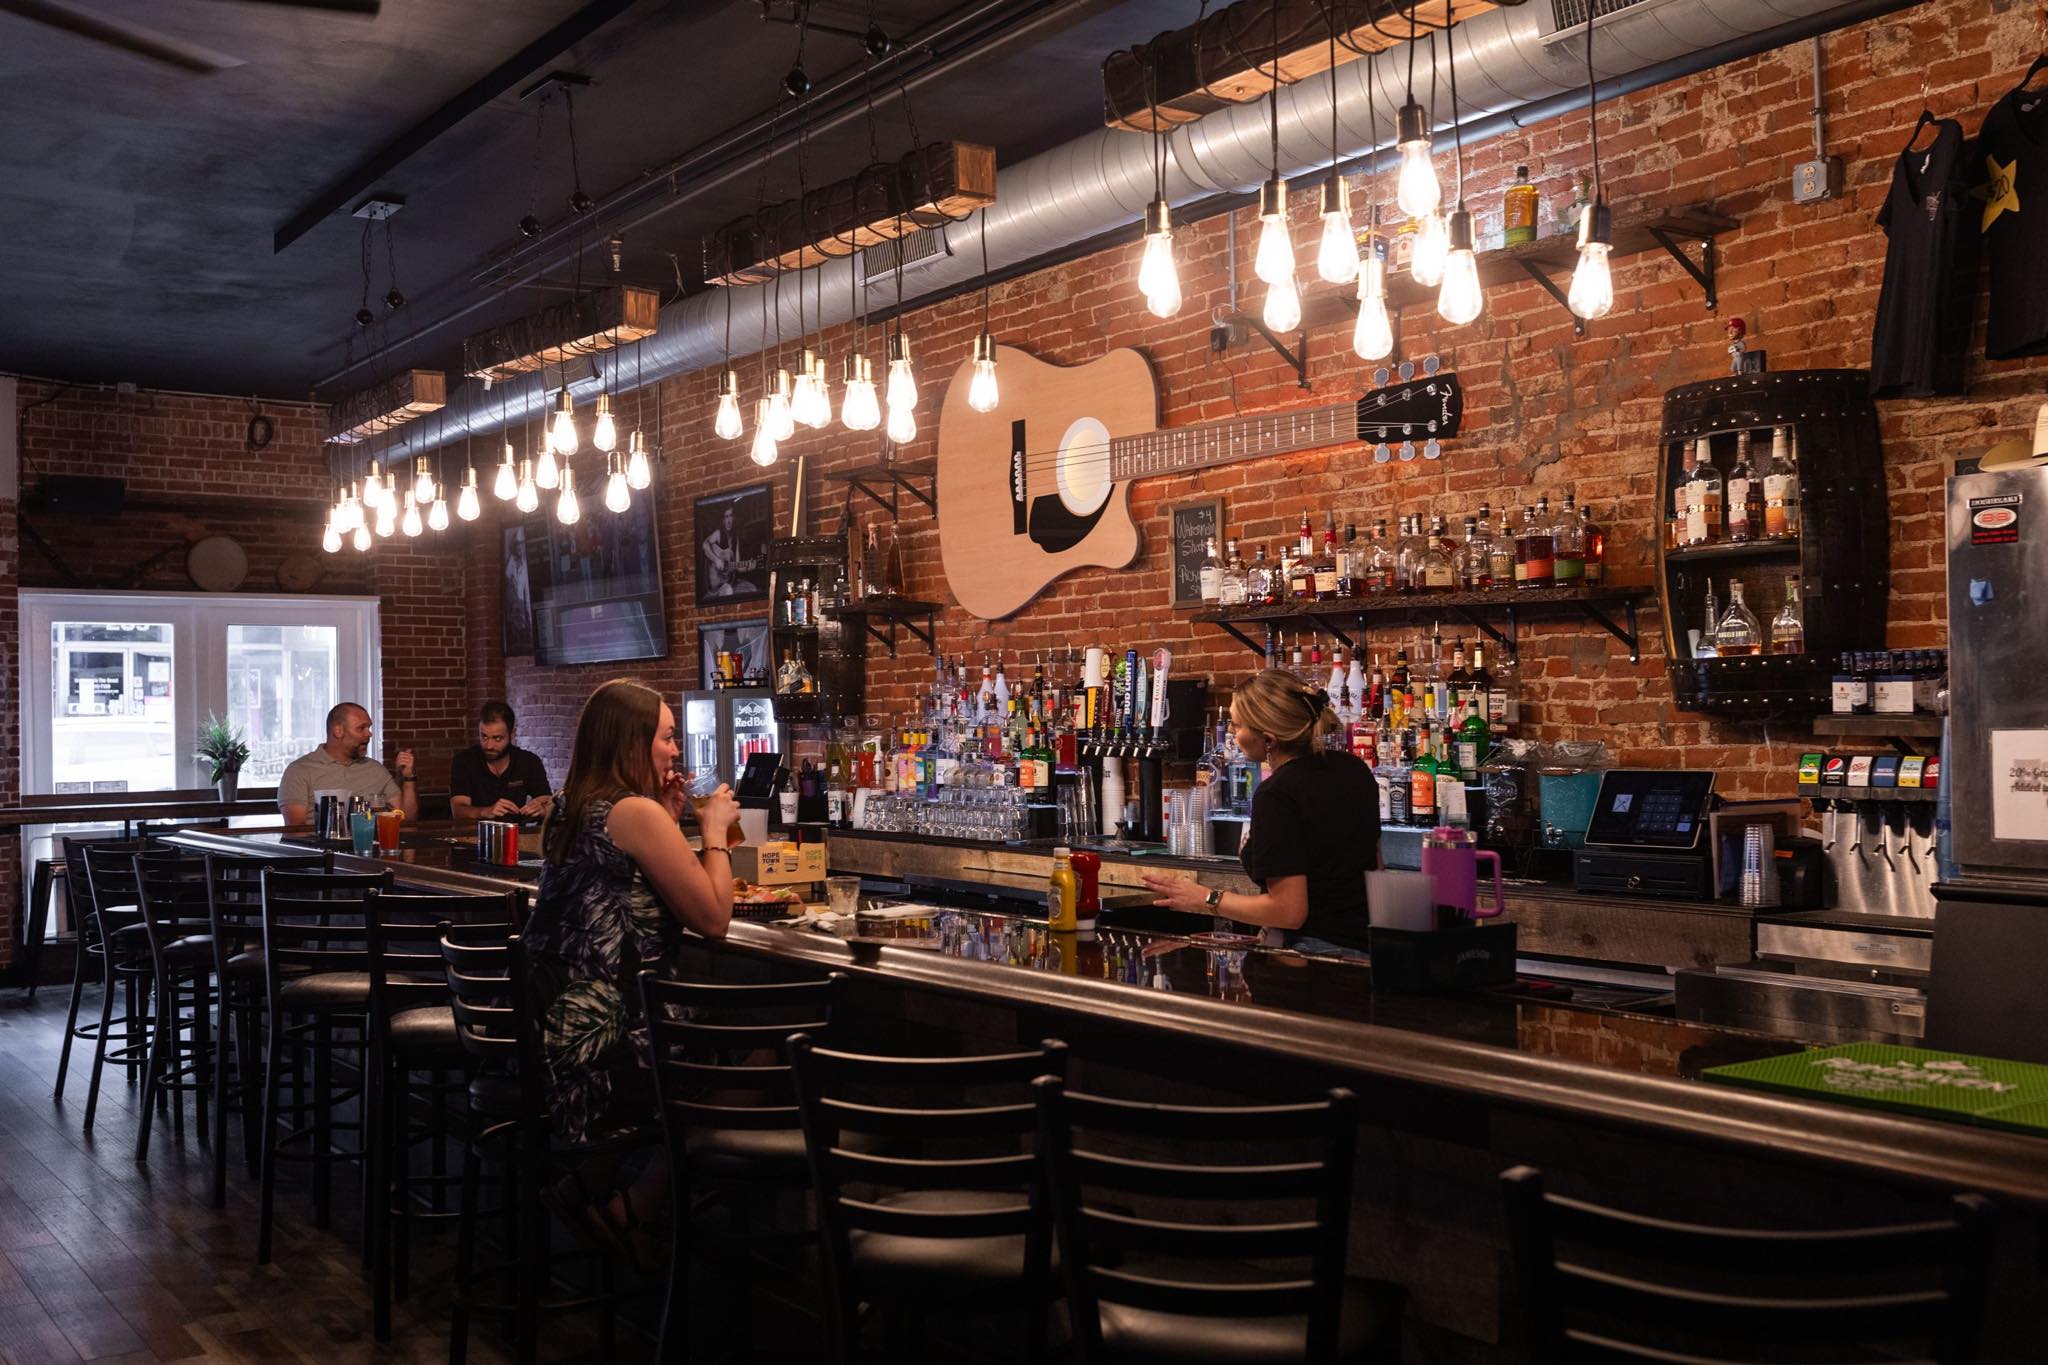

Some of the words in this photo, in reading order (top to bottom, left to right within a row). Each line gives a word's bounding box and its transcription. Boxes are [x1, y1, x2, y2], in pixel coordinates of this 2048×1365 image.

[1440, 384, 1453, 426] Fender
[735, 716, 753, 727] Red
[754, 716, 771, 726] Bul
